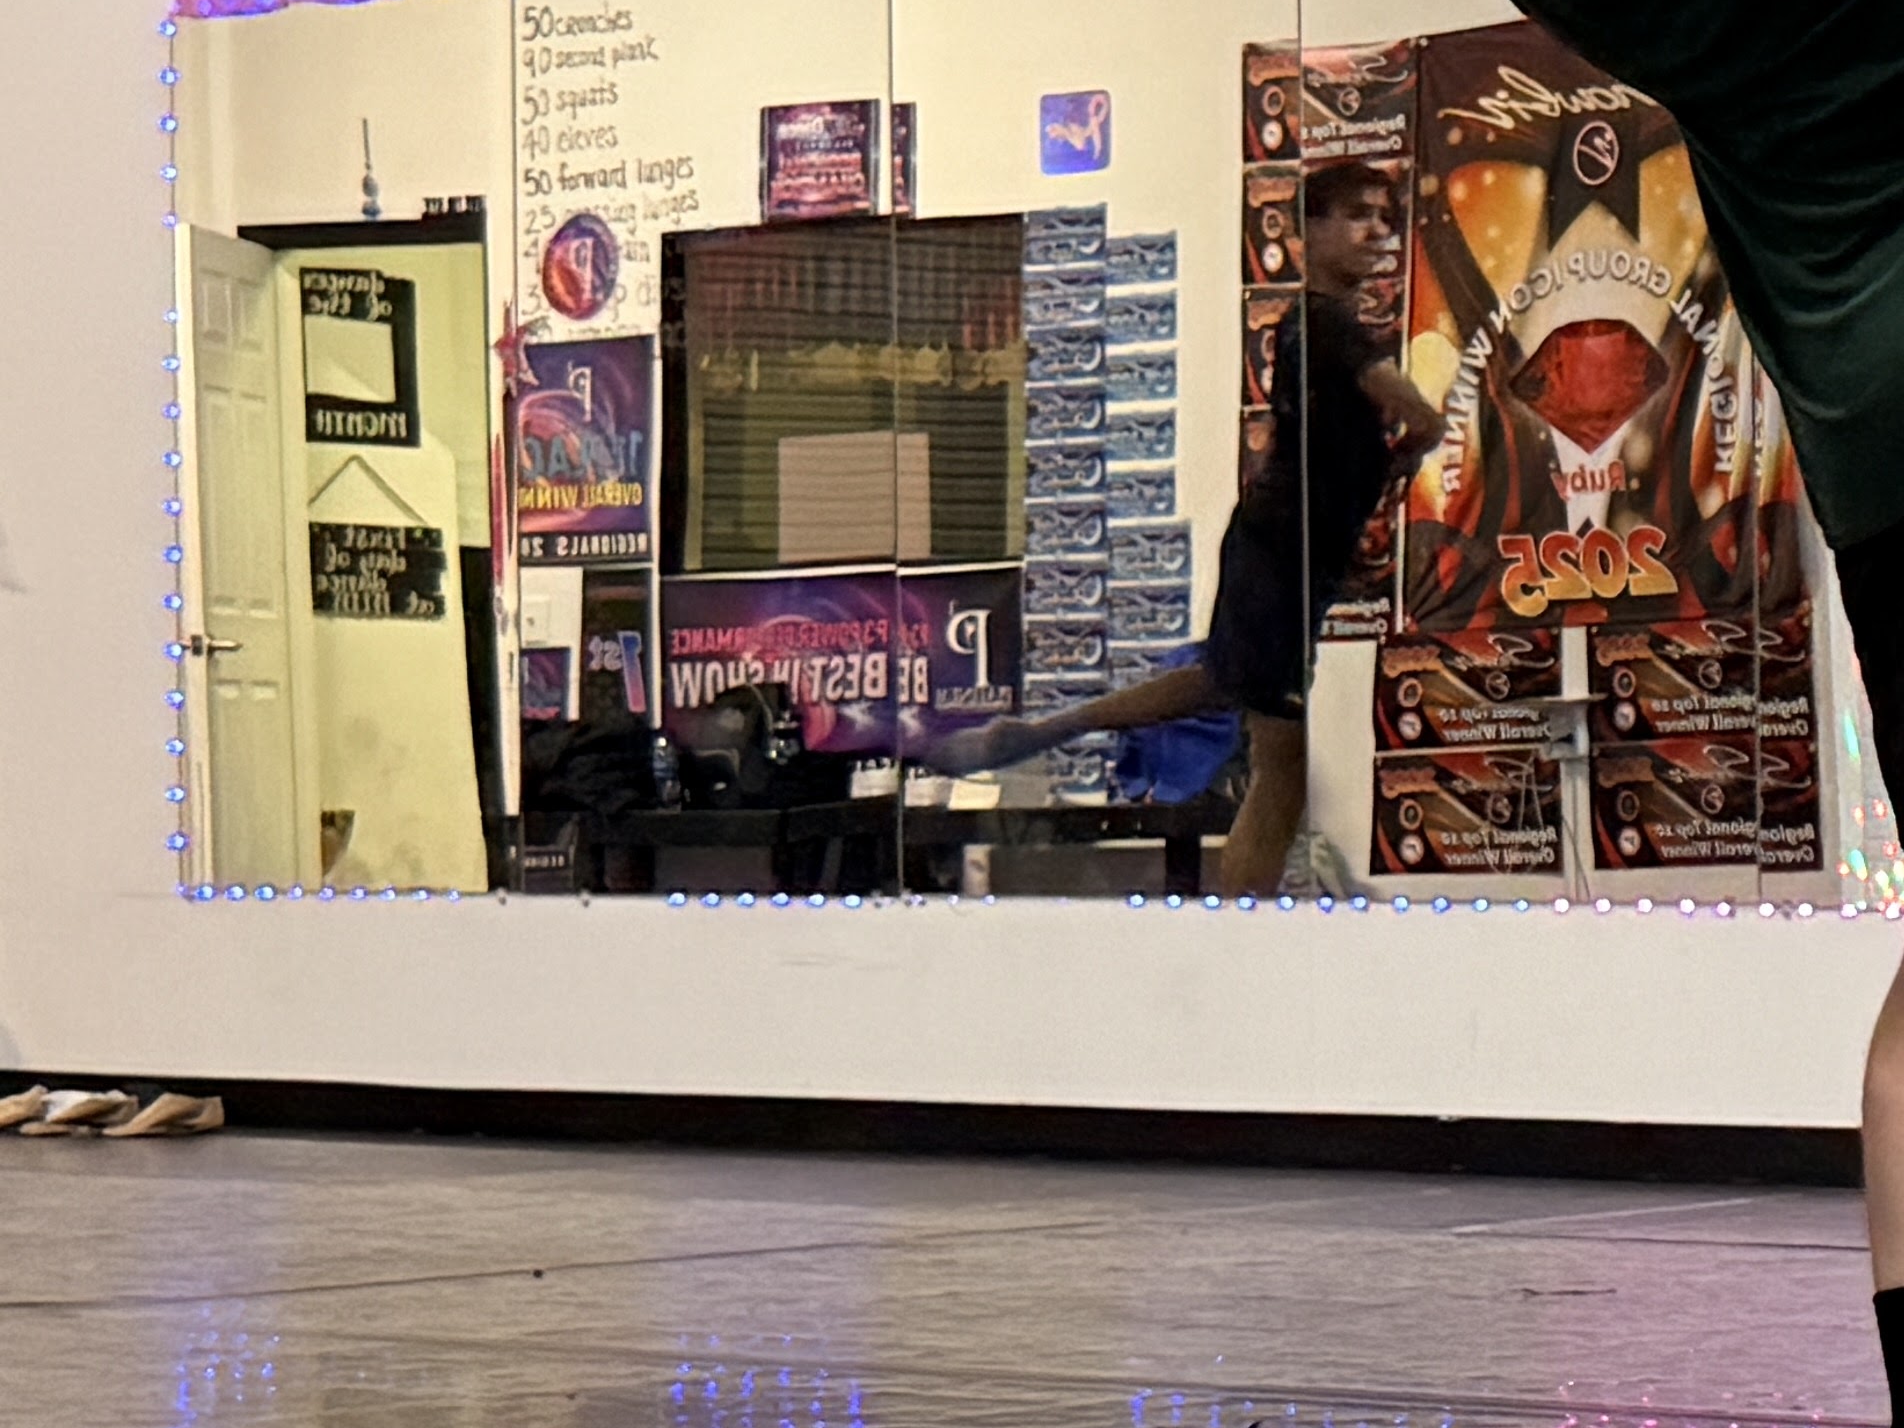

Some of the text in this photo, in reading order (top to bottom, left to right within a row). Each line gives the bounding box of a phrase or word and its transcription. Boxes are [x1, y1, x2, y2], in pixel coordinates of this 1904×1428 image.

[522, 6, 554, 42] 50
[521, 84, 551, 125] 50
[522, 125, 551, 161] 40
[524, 156, 694, 196] 50 forward lunges
[524, 204, 556, 235] 25
